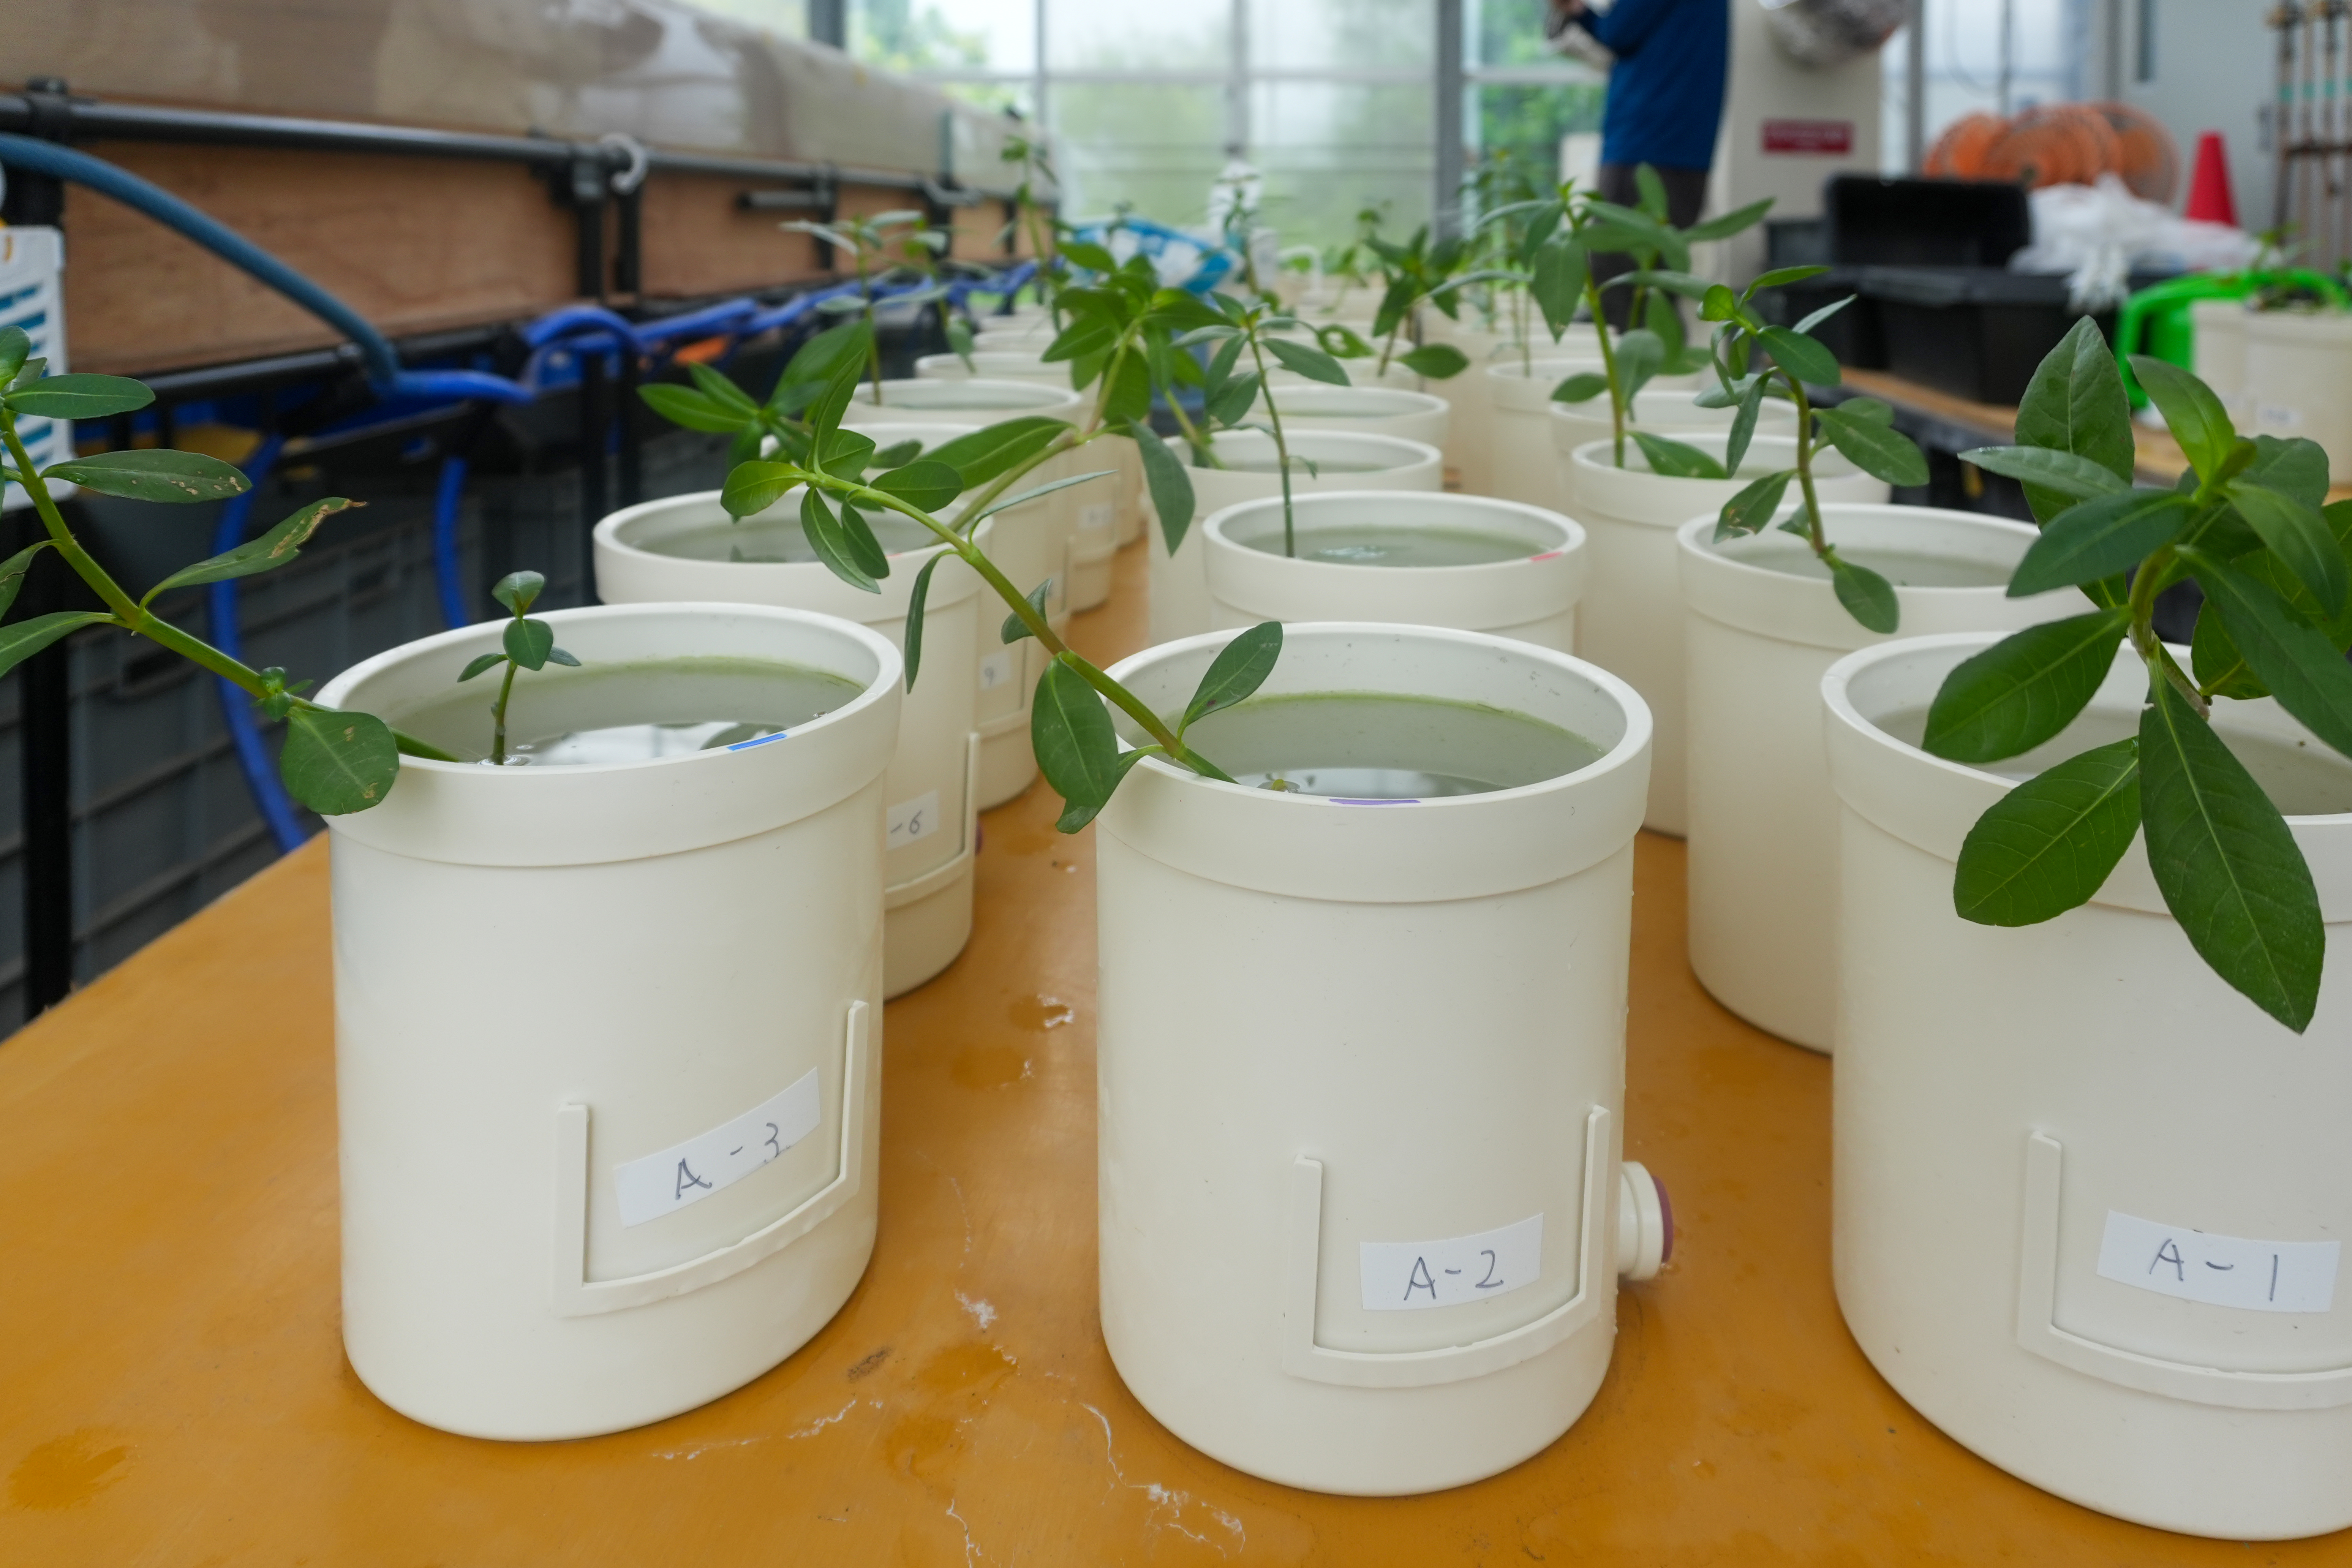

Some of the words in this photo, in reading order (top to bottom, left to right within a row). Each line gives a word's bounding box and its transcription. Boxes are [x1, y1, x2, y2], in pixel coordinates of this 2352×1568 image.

[890, 809, 923, 835] -6
[675, 1122, 779, 1200] A-3
[1403, 1249, 1504, 1301] A-2
[2149, 1238, 2278, 1302] A-1
